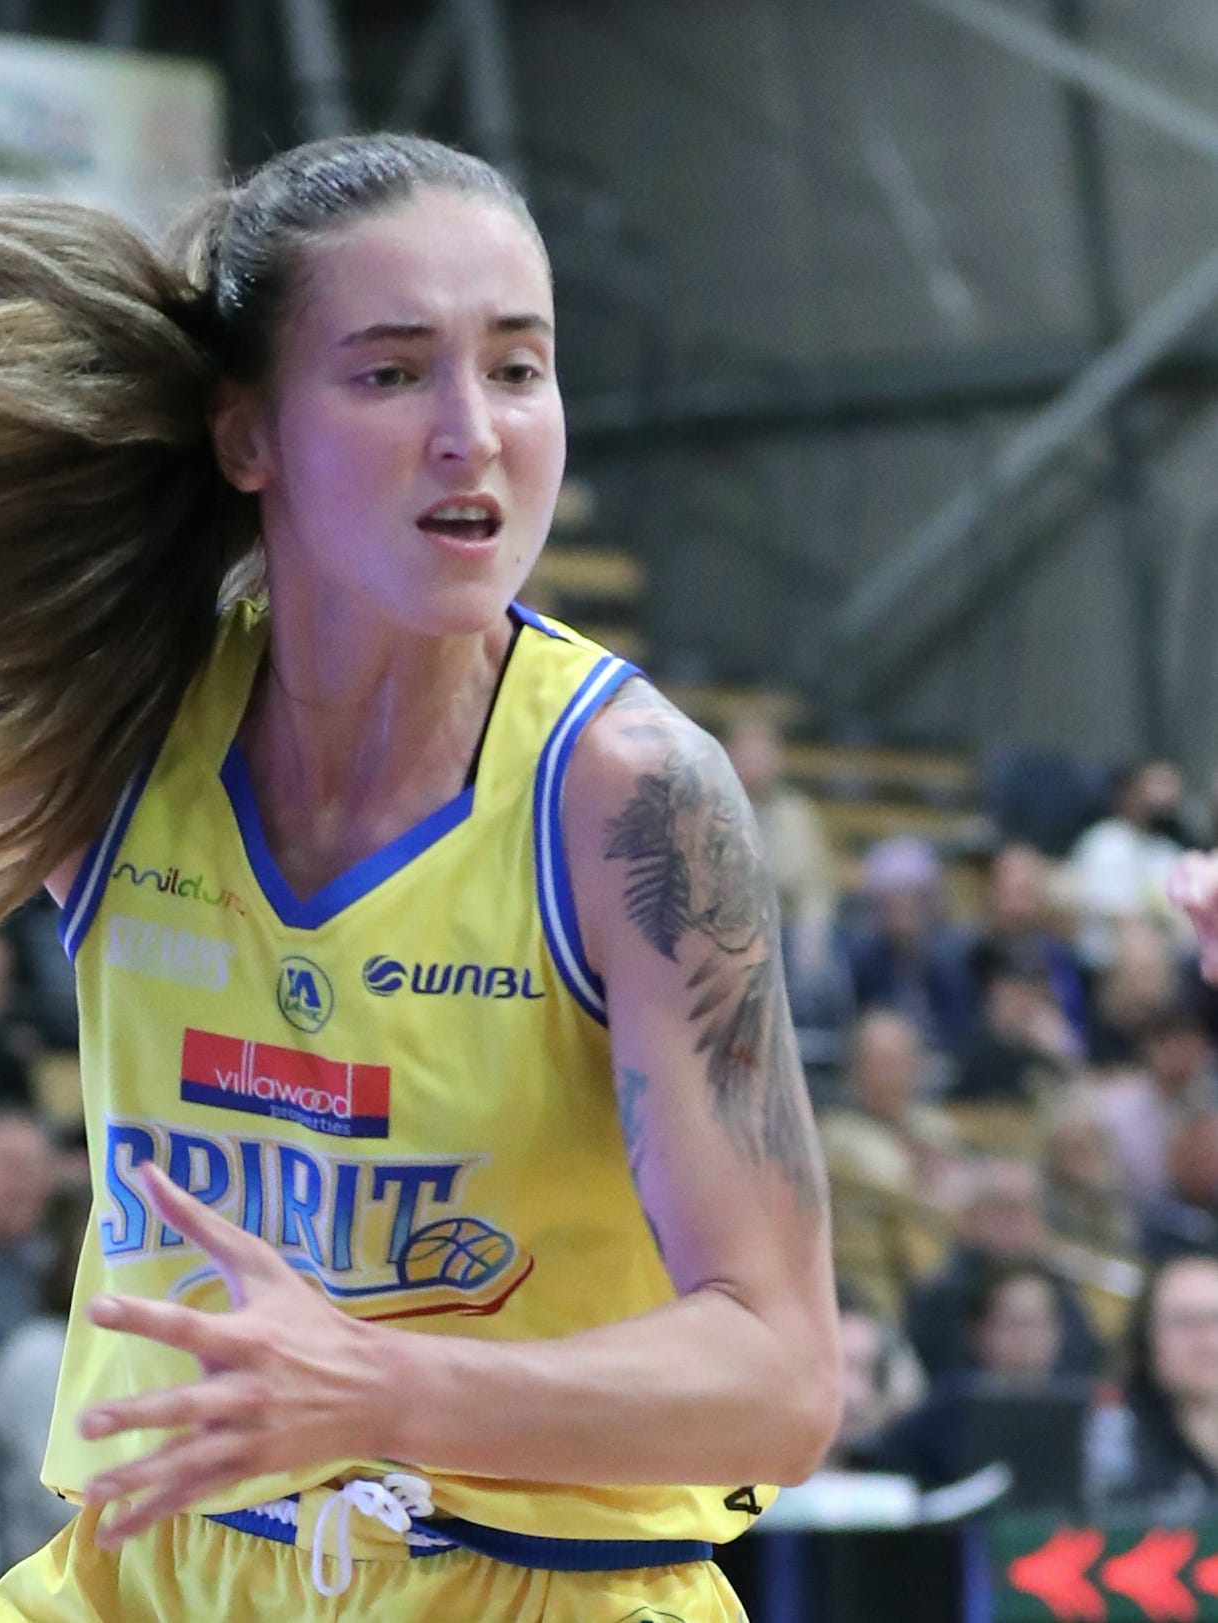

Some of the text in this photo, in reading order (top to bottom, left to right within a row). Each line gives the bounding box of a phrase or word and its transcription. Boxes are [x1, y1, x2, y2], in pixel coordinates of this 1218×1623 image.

[111, 863, 246, 917] mildur
[411, 963, 546, 999] WNBL
[215, 1039, 353, 1120] villawood
[99, 1118, 468, 1274] SPIRIT
